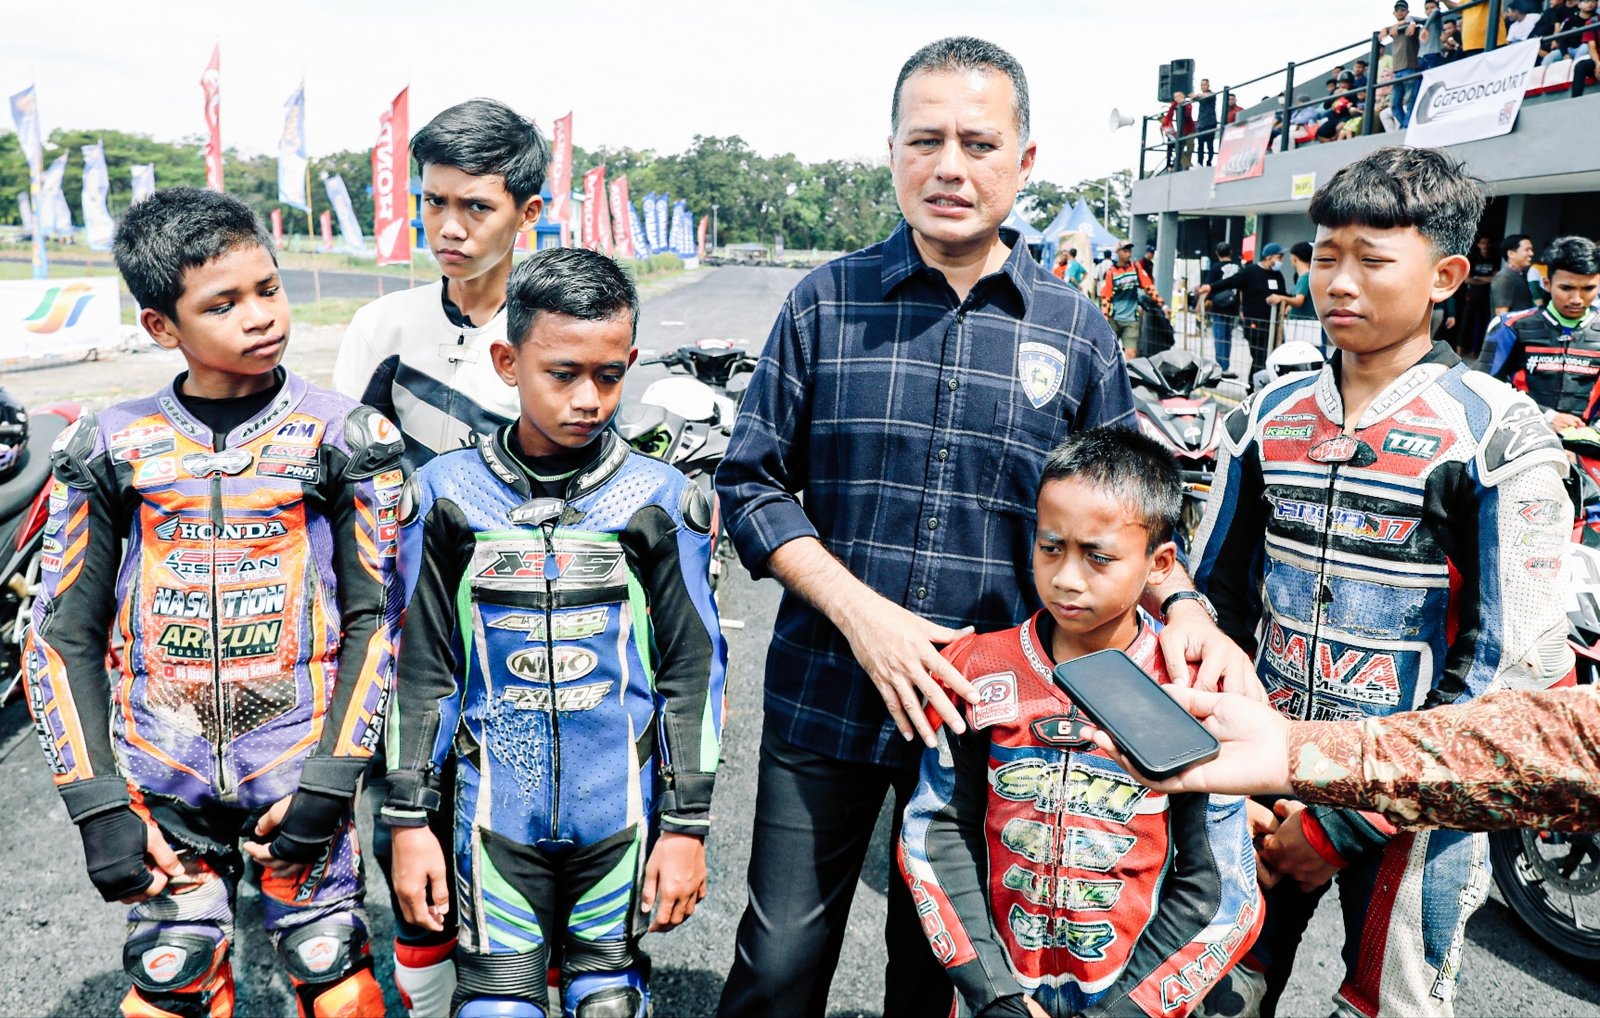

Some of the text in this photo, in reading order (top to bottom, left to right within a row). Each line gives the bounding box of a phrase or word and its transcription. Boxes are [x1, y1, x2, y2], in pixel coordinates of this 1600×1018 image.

[1433, 71, 1527, 108] GGFOODCOURT
[267, 446, 316, 458] KYB
[179, 520, 288, 541] HONDA
[1268, 620, 1399, 691] DAVA
[981, 685, 1008, 705] 43
